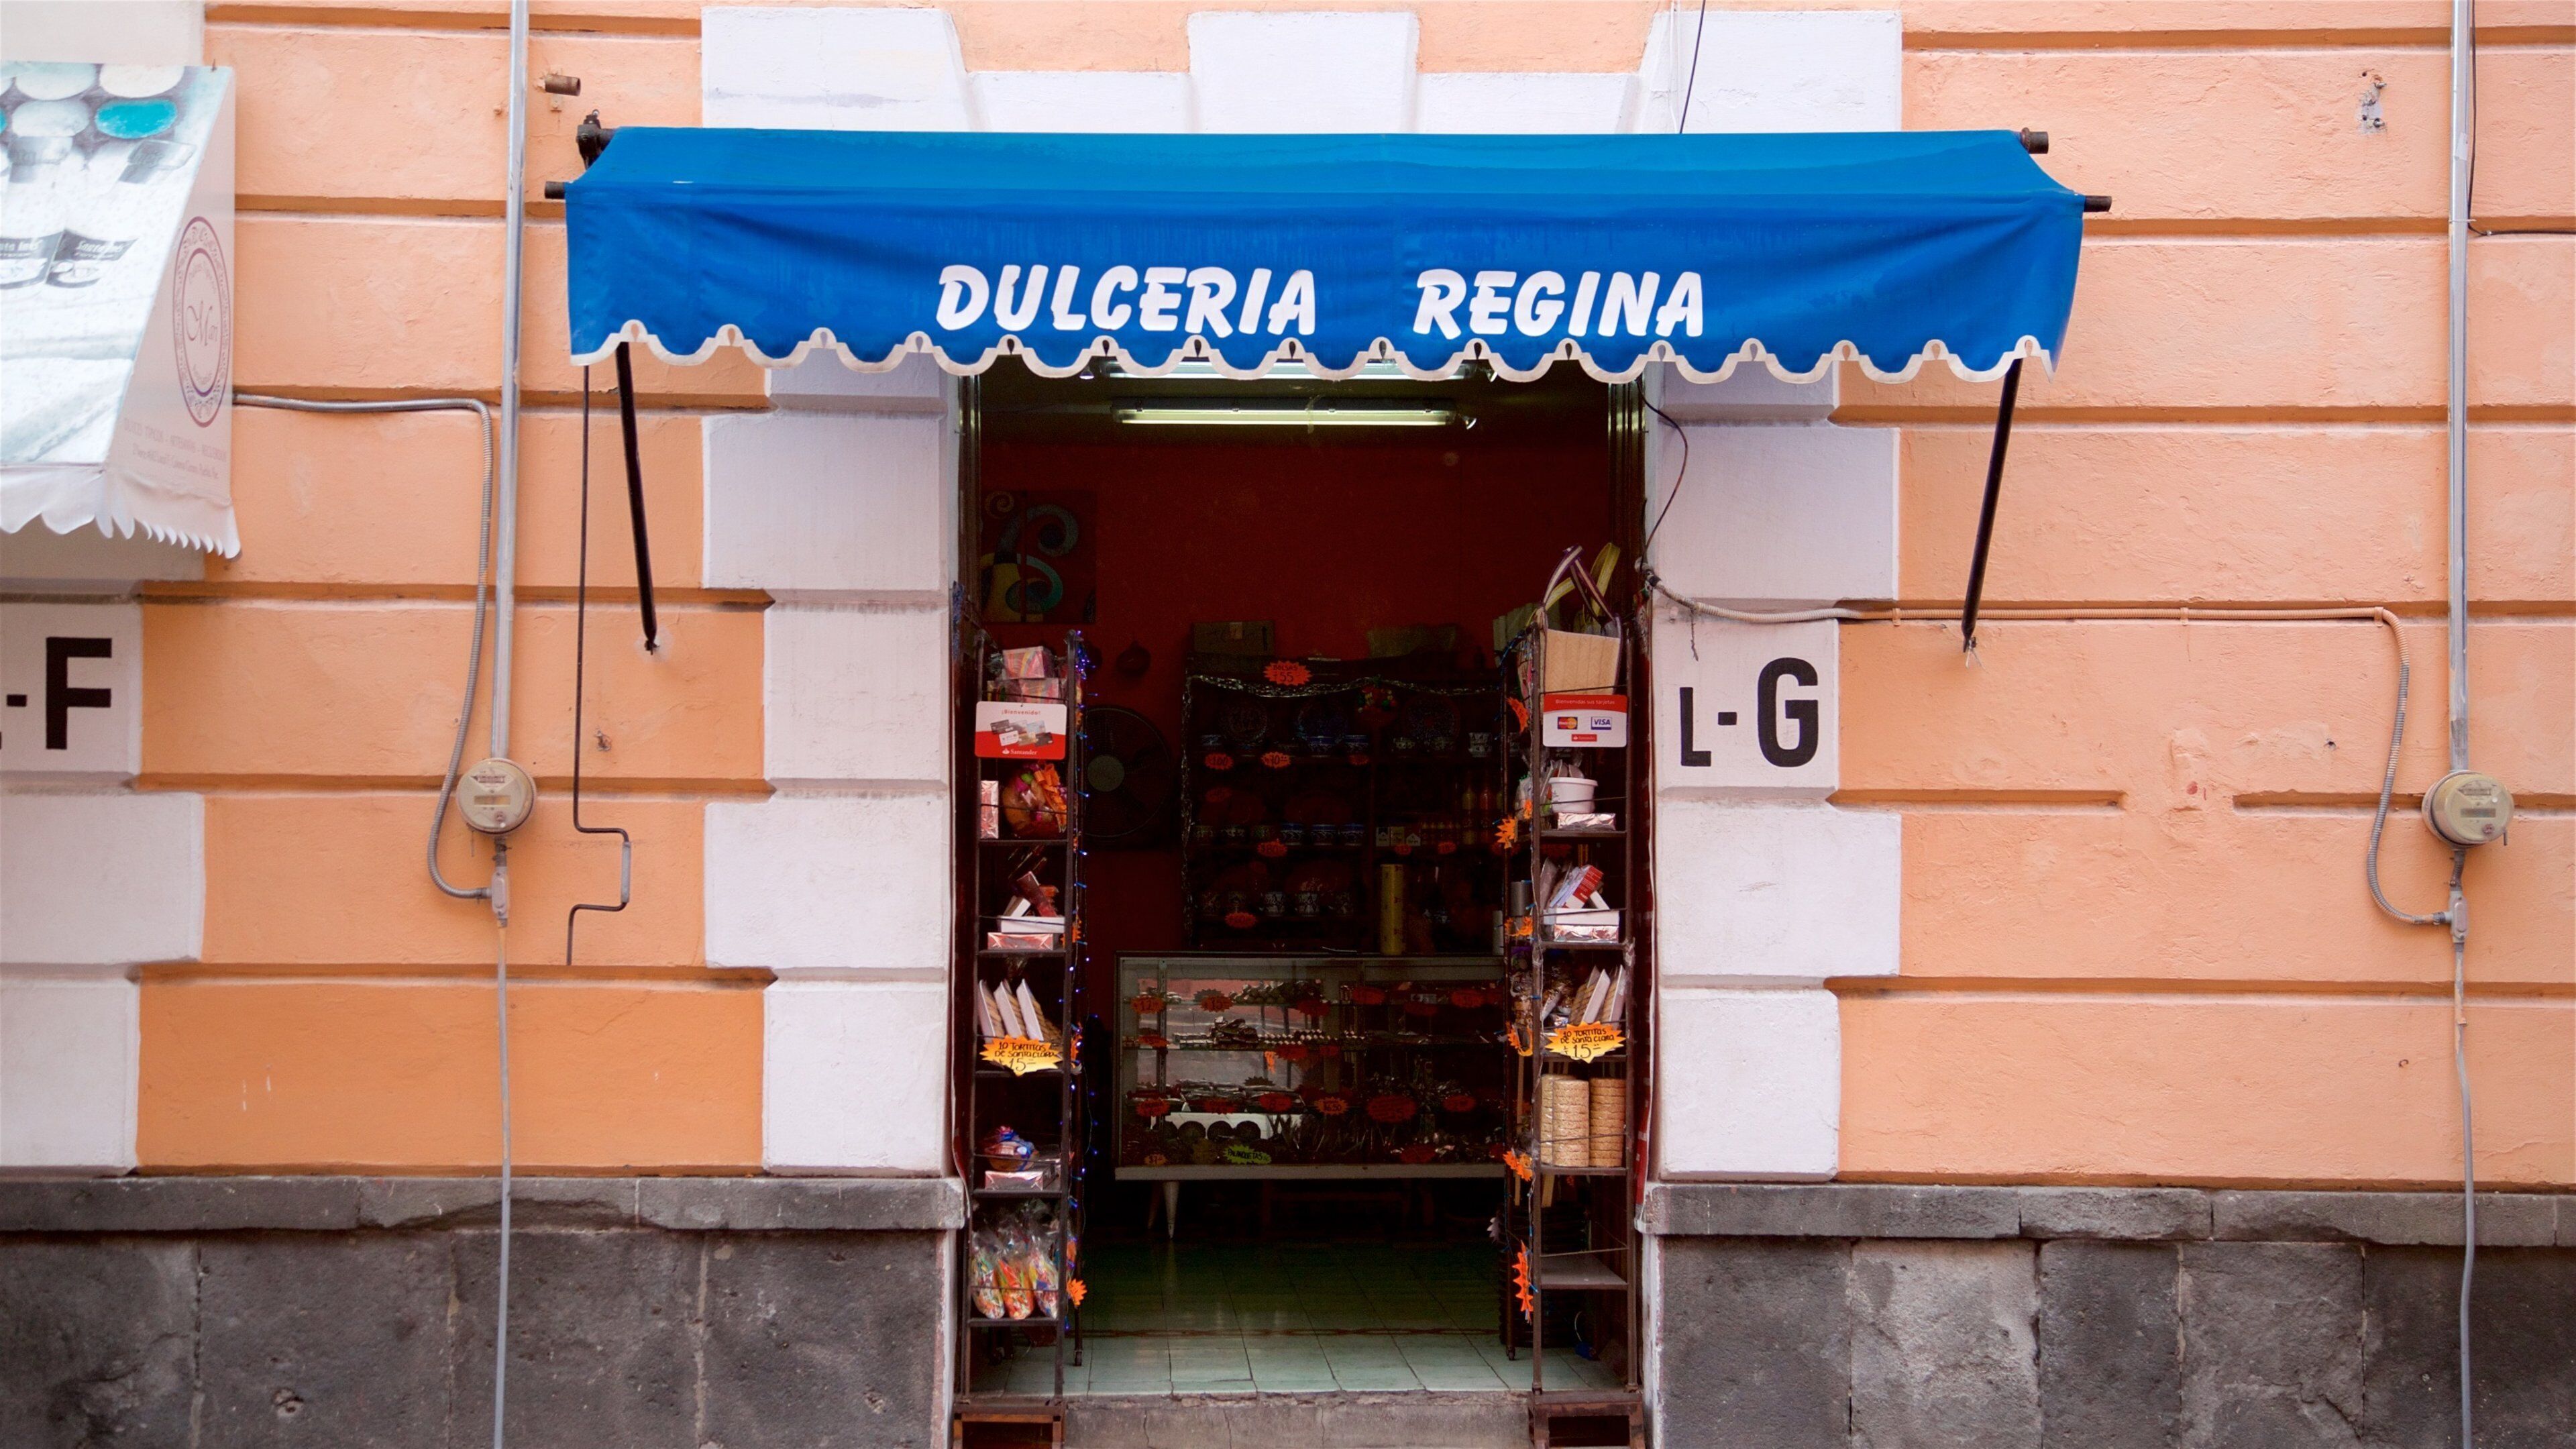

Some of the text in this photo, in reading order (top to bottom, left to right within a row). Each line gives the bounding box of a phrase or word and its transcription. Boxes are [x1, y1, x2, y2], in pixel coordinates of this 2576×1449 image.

[936, 264, 1703, 339] DULCERIA REGINA
[999, 1042, 1009, 1050] 10
